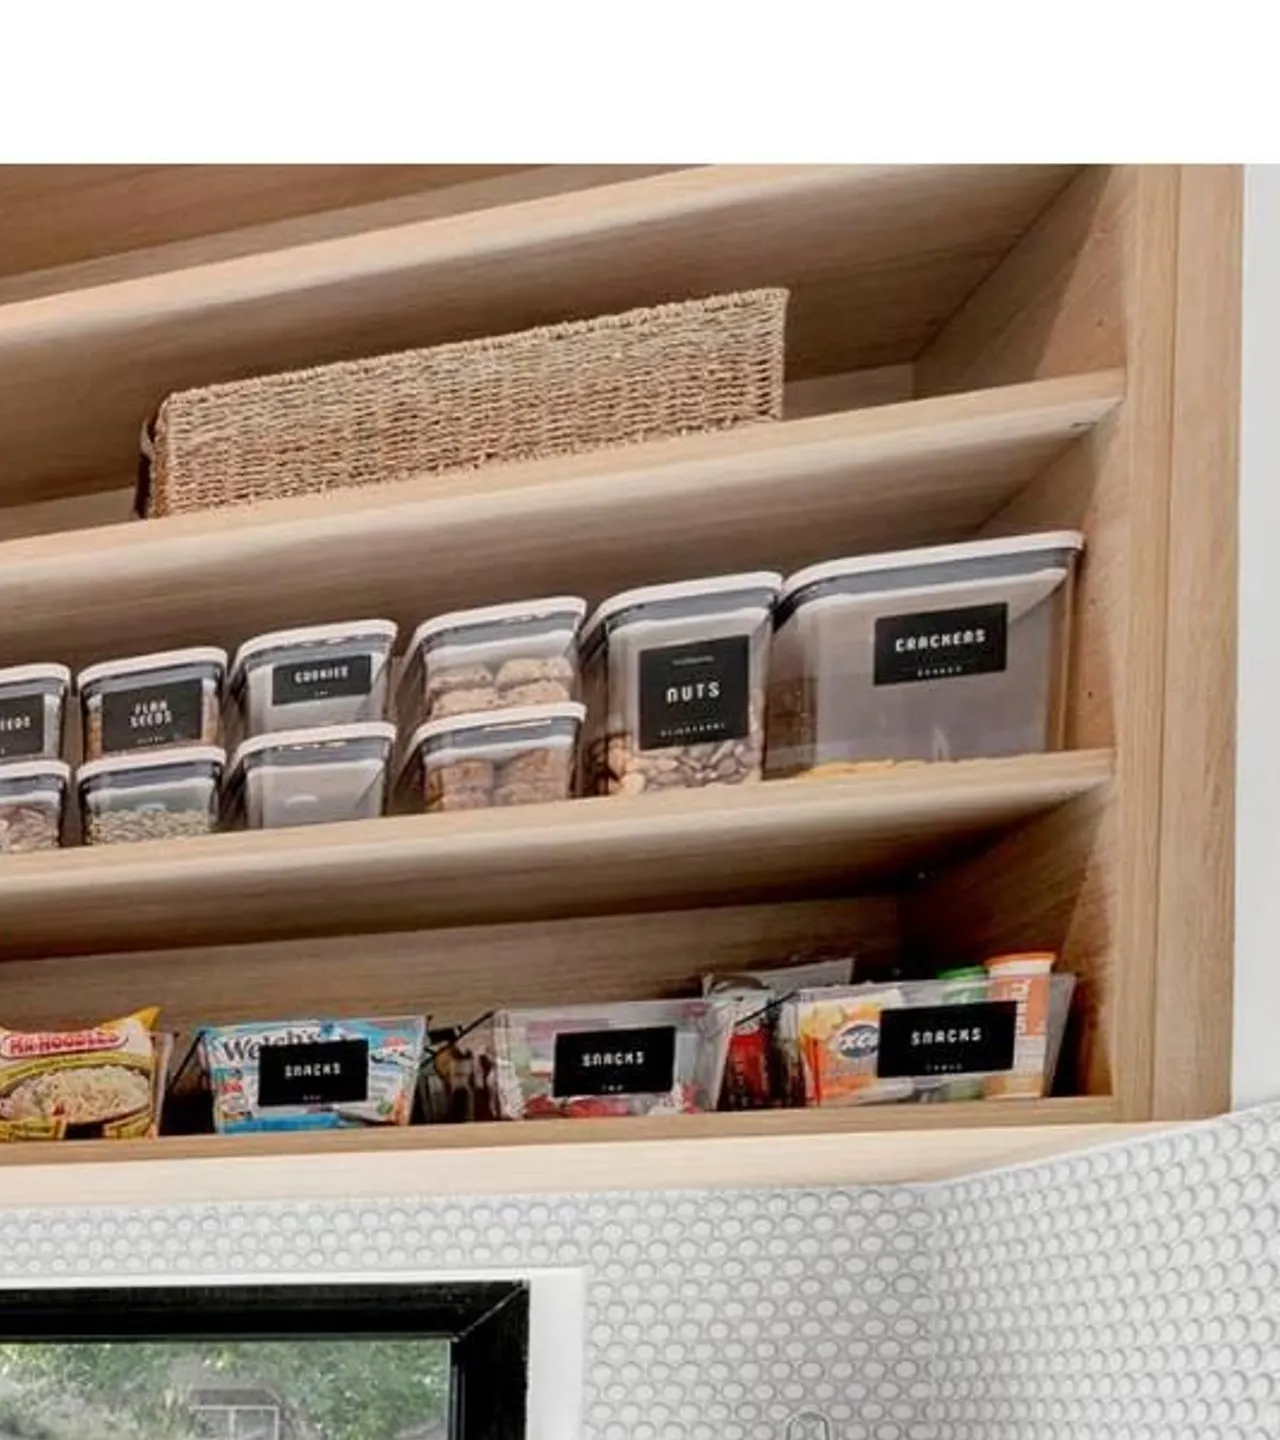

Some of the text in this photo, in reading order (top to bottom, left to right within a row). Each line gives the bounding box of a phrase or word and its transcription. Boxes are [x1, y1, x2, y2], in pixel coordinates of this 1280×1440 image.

[895, 629, 986, 653] CRACKERS
[666, 681, 720, 704] NUTS
[911, 1026, 982, 1046] SNACKS
[581, 1050, 645, 1068] SNACKS
[284, 1061, 341, 1079] SNACKS
